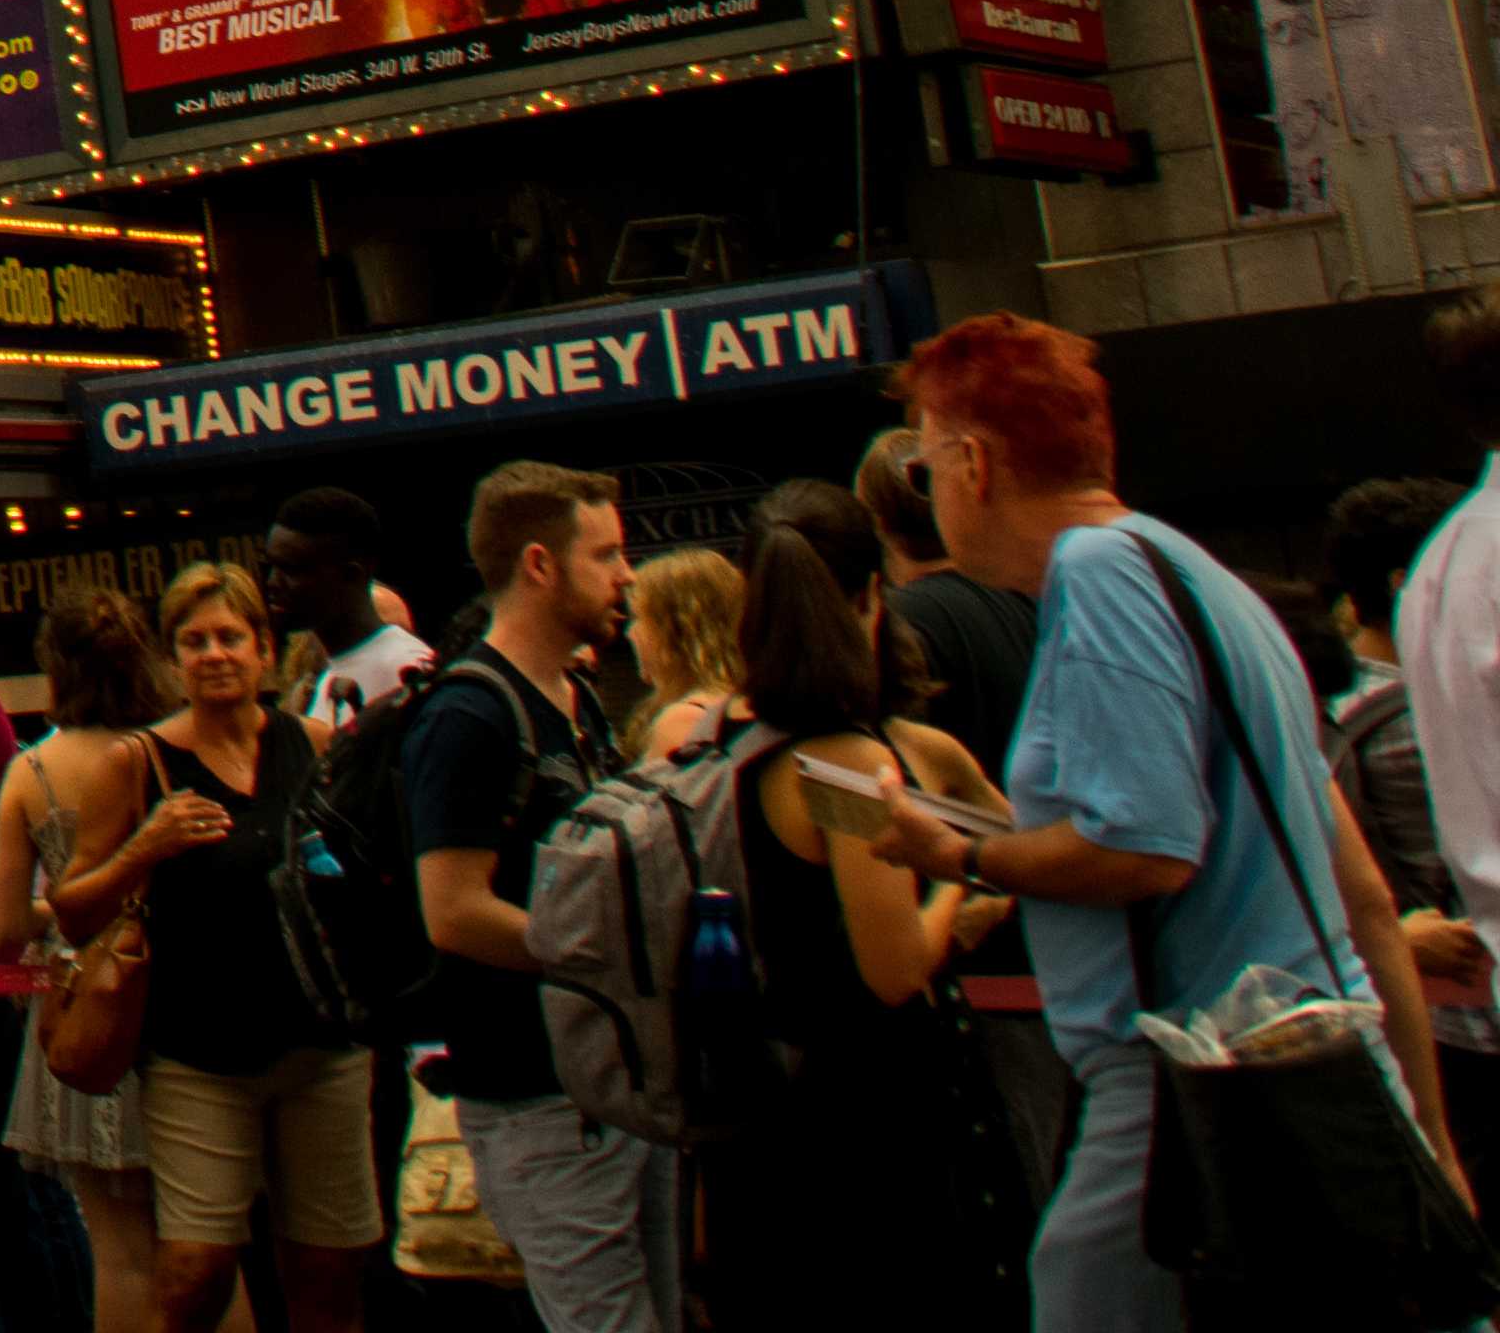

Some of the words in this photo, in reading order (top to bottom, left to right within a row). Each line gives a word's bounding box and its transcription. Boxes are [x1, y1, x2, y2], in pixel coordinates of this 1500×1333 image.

[157, 20, 222, 54] BEST
[208, 83, 247, 108] New
[248, 72, 297, 103] World
[299, 64, 362, 96] Stages,
[364, 57, 396, 82] 340
[424, 45, 465, 72] 50th
[467, 39, 494, 64] St.
[994, 95, 1043, 128] OPEN
[1043, 102, 1066, 131] 24
[101, 371, 379, 453] CHANGE
[394, 332, 648, 418] MONEY
[699, 305, 859, 377] ATM
